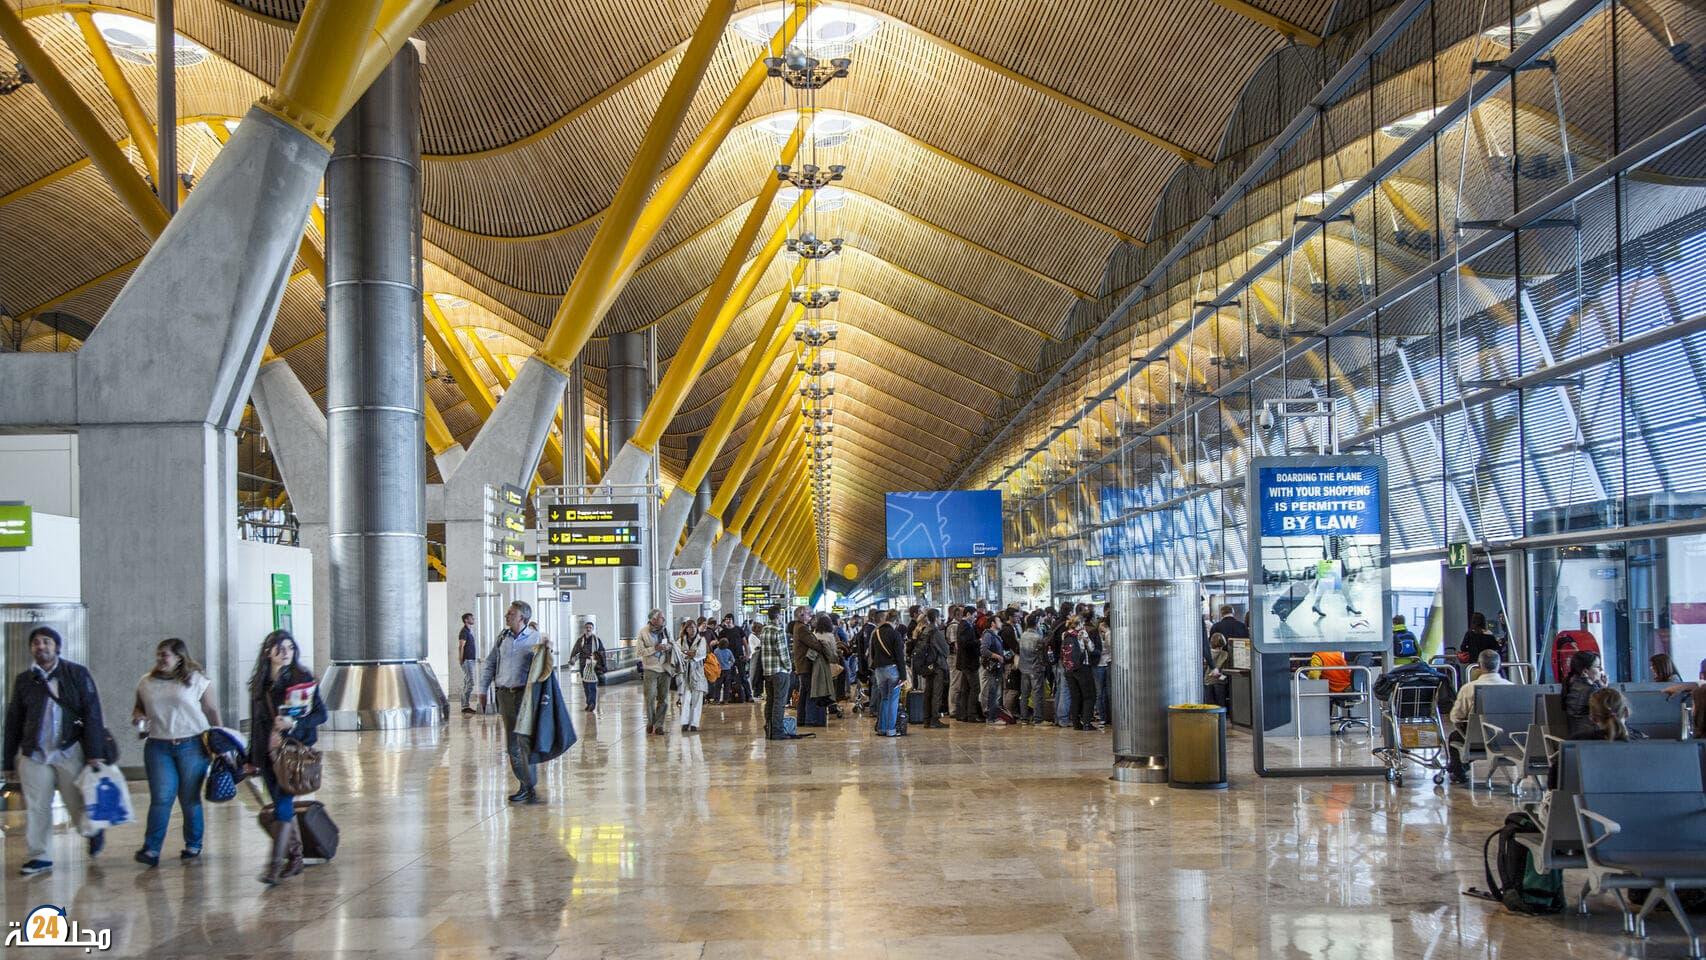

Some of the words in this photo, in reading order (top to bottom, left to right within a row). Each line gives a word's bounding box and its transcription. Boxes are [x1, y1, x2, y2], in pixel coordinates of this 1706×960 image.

[1276, 473, 1317, 482] BOARDING
[1319, 473, 1335, 481] THE
[1336, 472, 1362, 481] PLANE
[1269, 487, 1293, 498] WITH
[1295, 486, 1321, 497] YOUR
[1323, 485, 1371, 497] SHOPPING
[1275, 502, 1288, 512] IS
[1291, 500, 1366, 512] PERMITTED
[1283, 516, 1310, 530] BY
[1315, 515, 1359, 530] LAW
